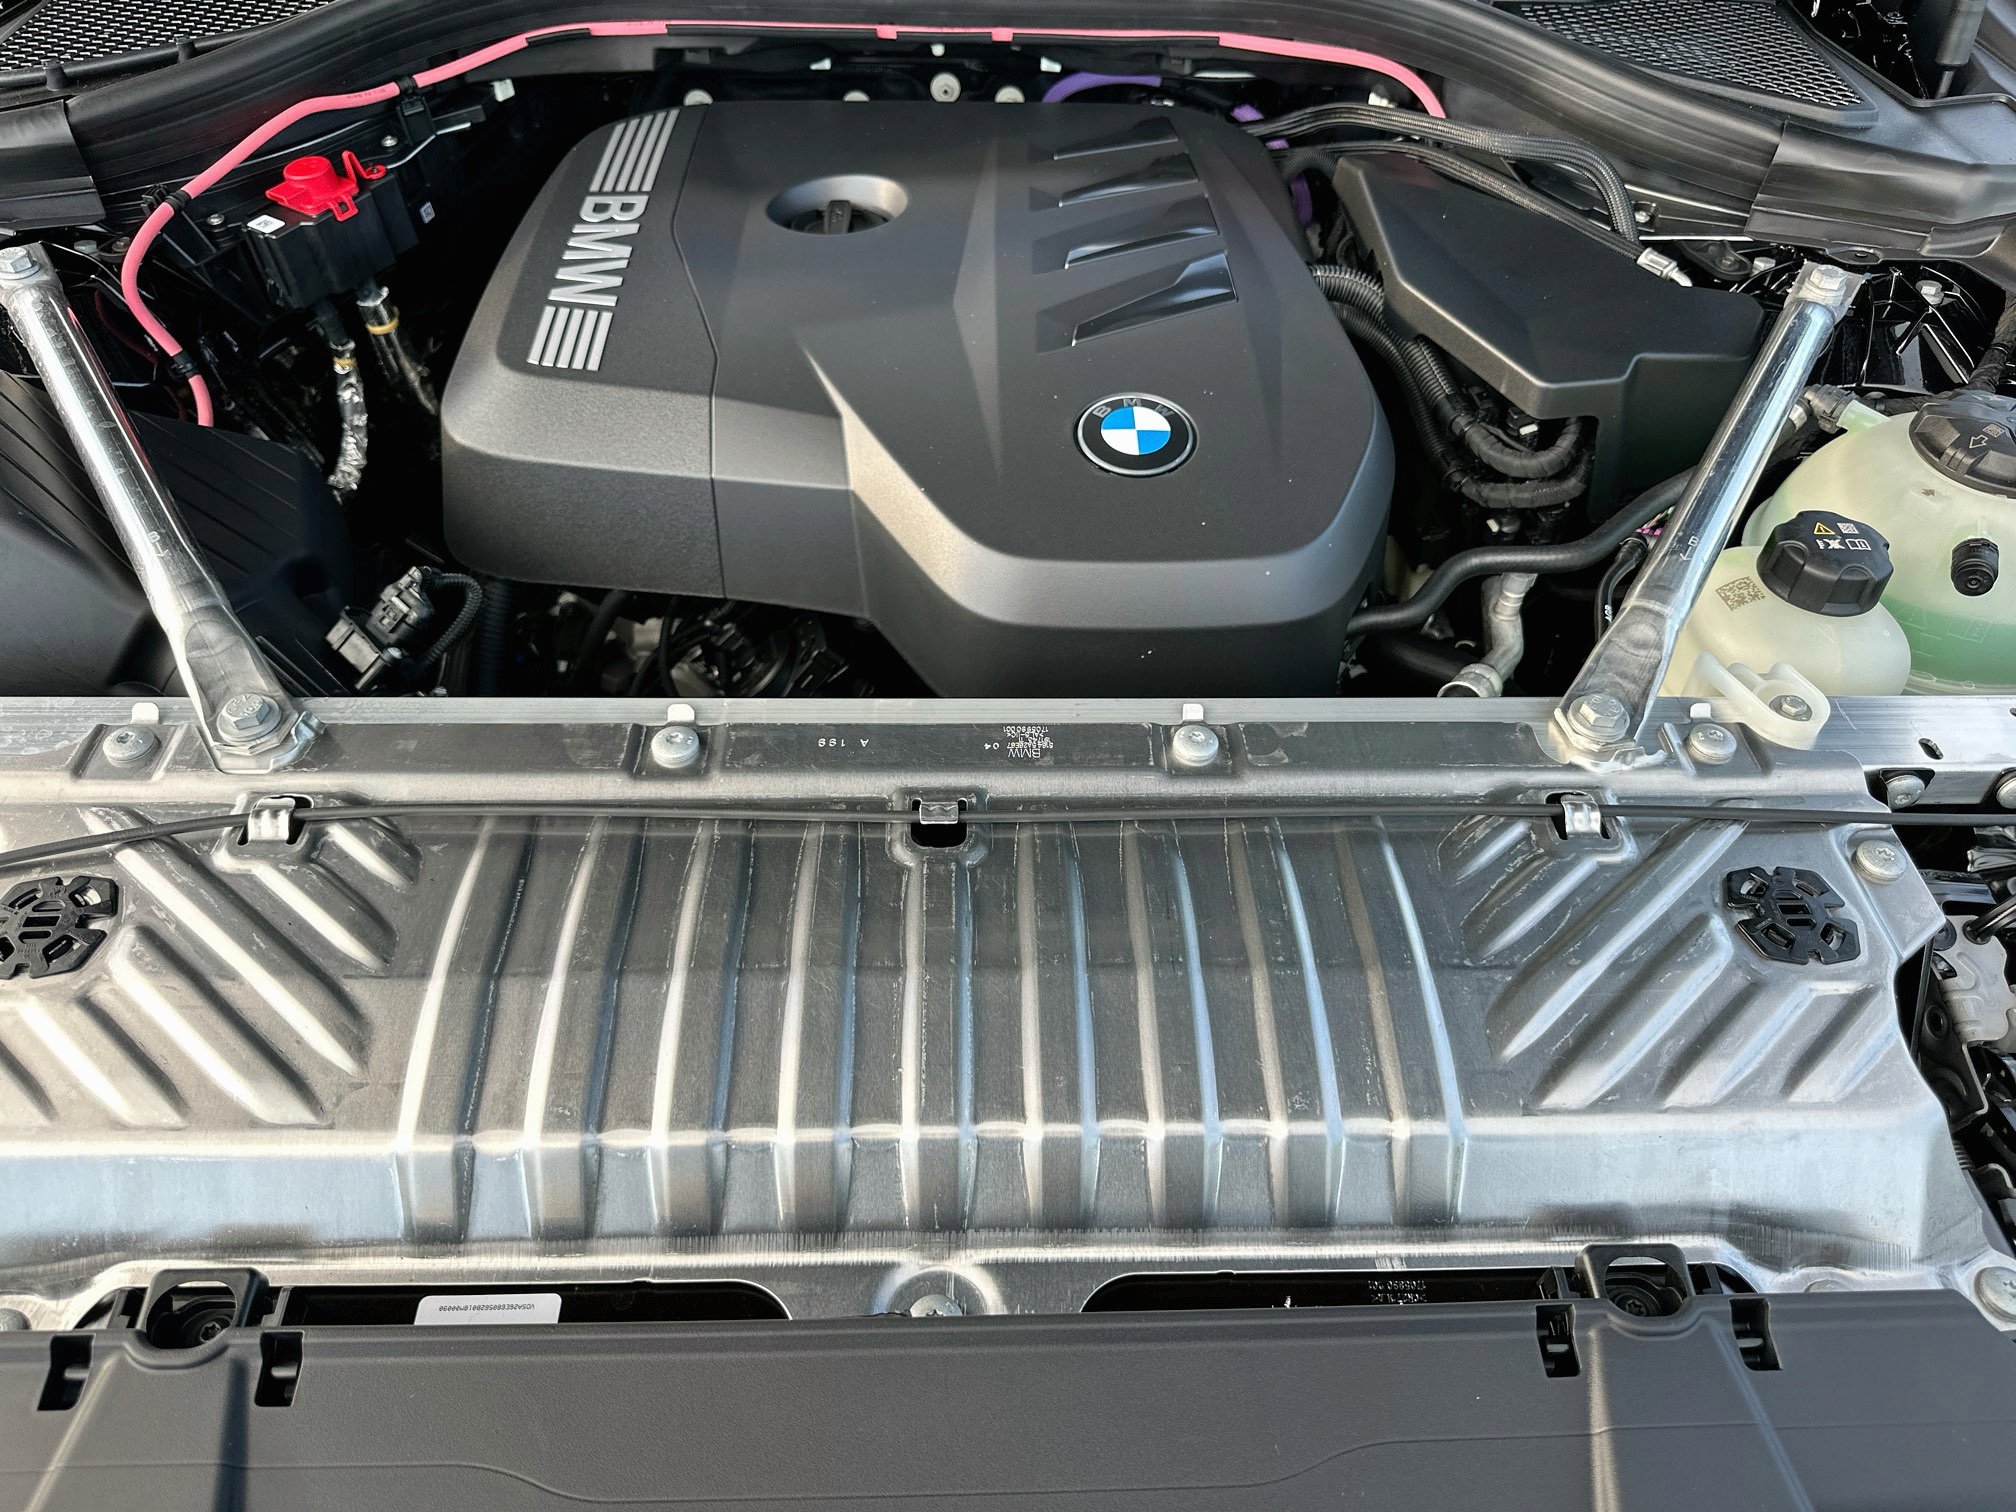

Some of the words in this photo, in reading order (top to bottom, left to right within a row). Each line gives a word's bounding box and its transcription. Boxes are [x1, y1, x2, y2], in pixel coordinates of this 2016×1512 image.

[547, 193, 649, 307] BMW
[1092, 397, 1175, 419] BMW
[1008, 748, 1041, 759] BMW
